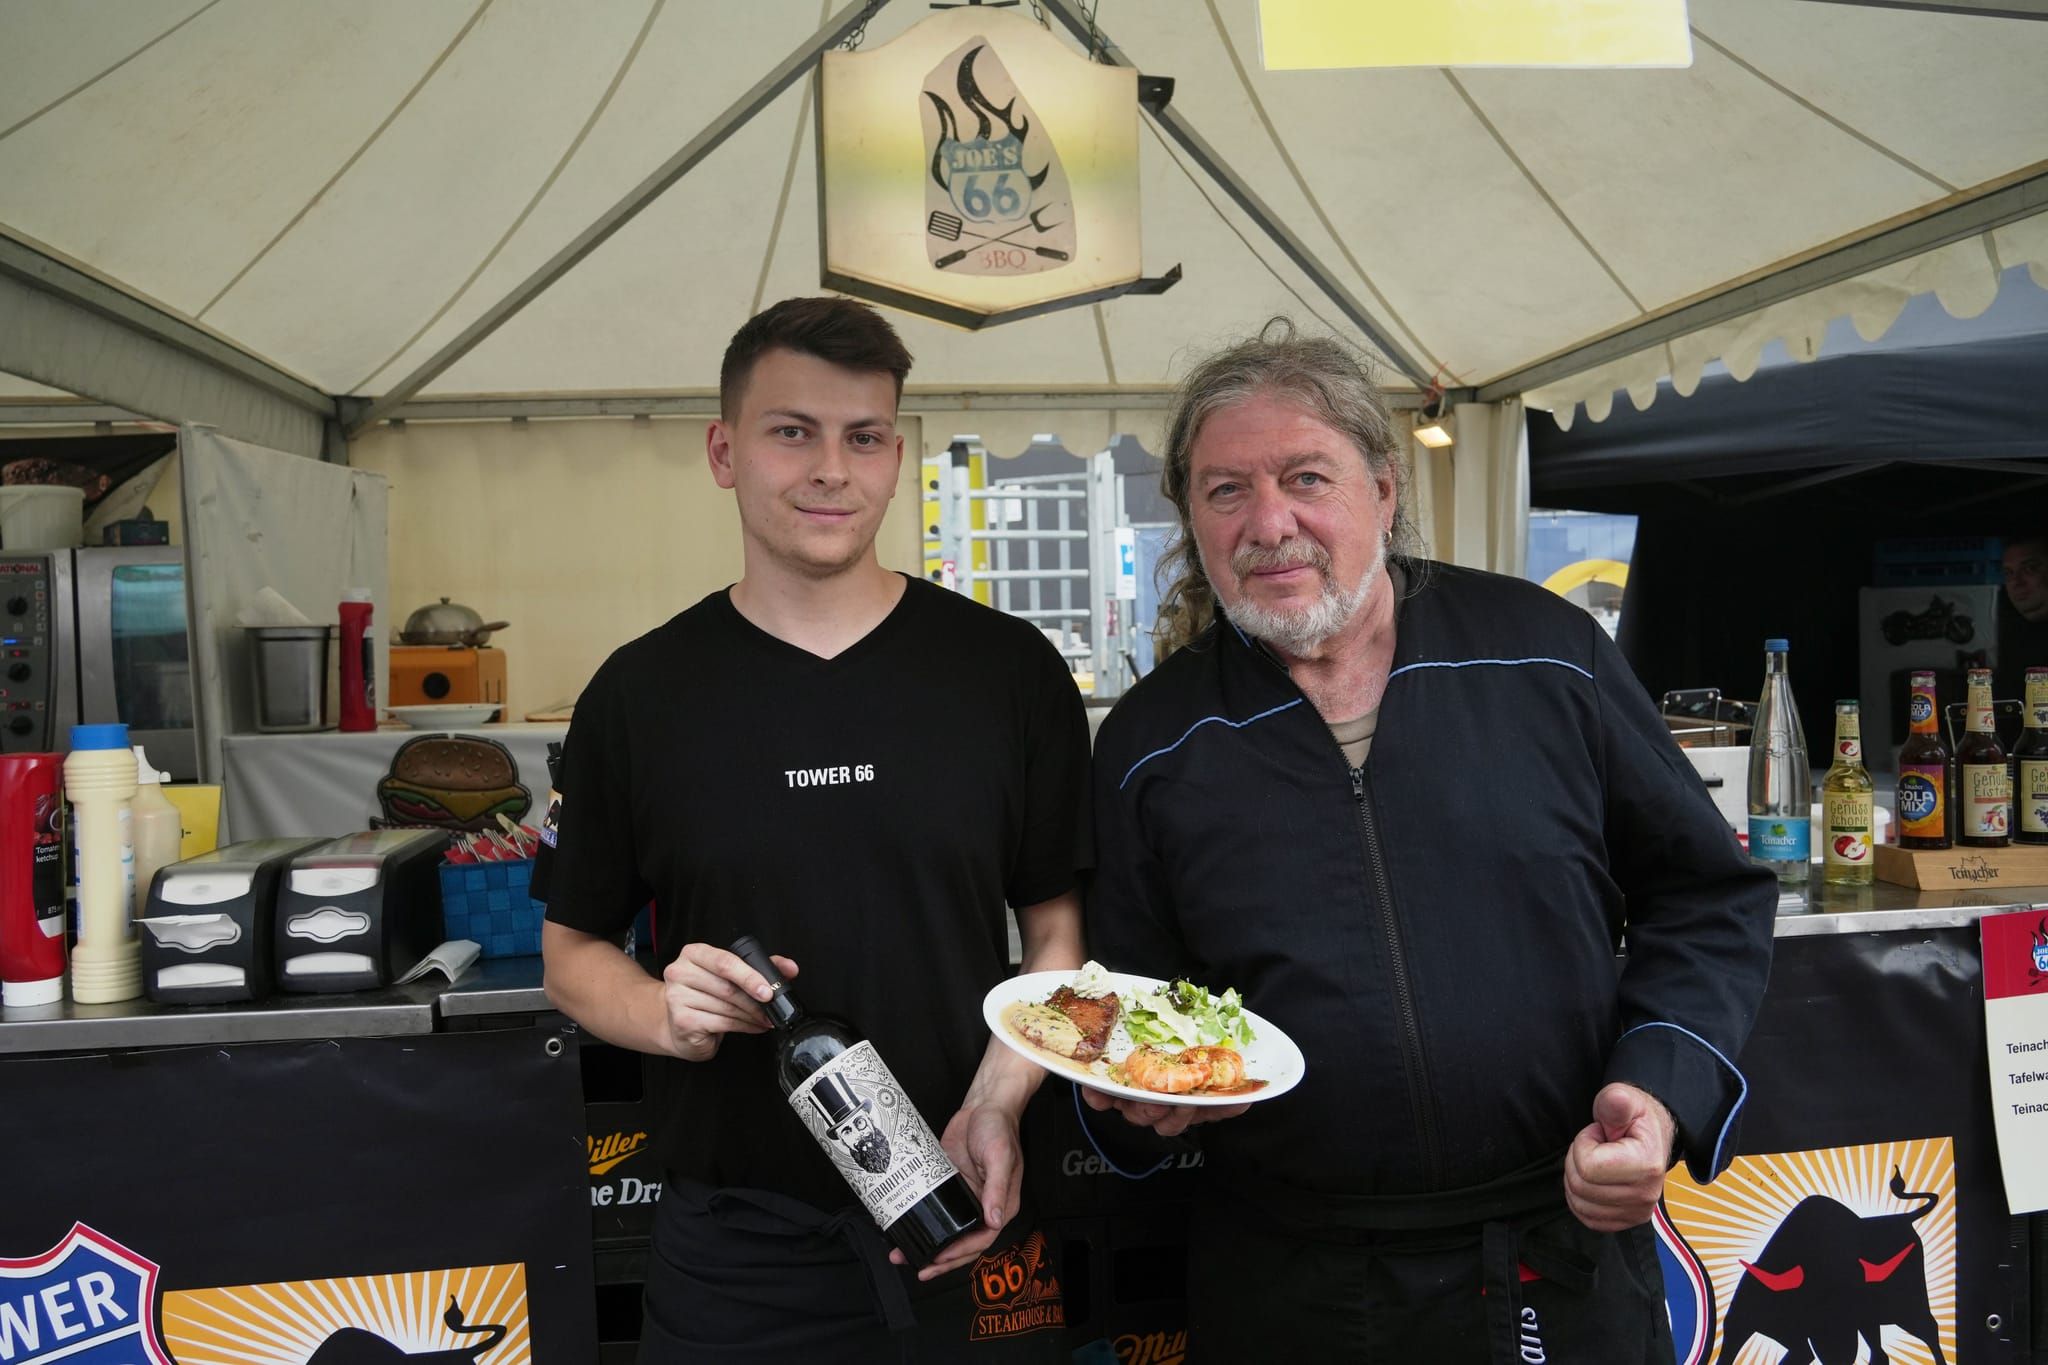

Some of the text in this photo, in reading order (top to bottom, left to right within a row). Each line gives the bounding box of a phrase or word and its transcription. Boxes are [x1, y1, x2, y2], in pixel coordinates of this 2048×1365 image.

[953, 144, 1019, 169] JOE'S
[963, 173, 1021, 218] 66
[785, 764, 874, 788] TOWER 66
[1830, 800, 1869, 815] Genuss
[1898, 790, 1935, 802] COLA
[1901, 800, 1928, 812] MIX
[981, 1259, 1024, 1300] 66
[978, 1304, 1045, 1335] STEAKHOUSE
